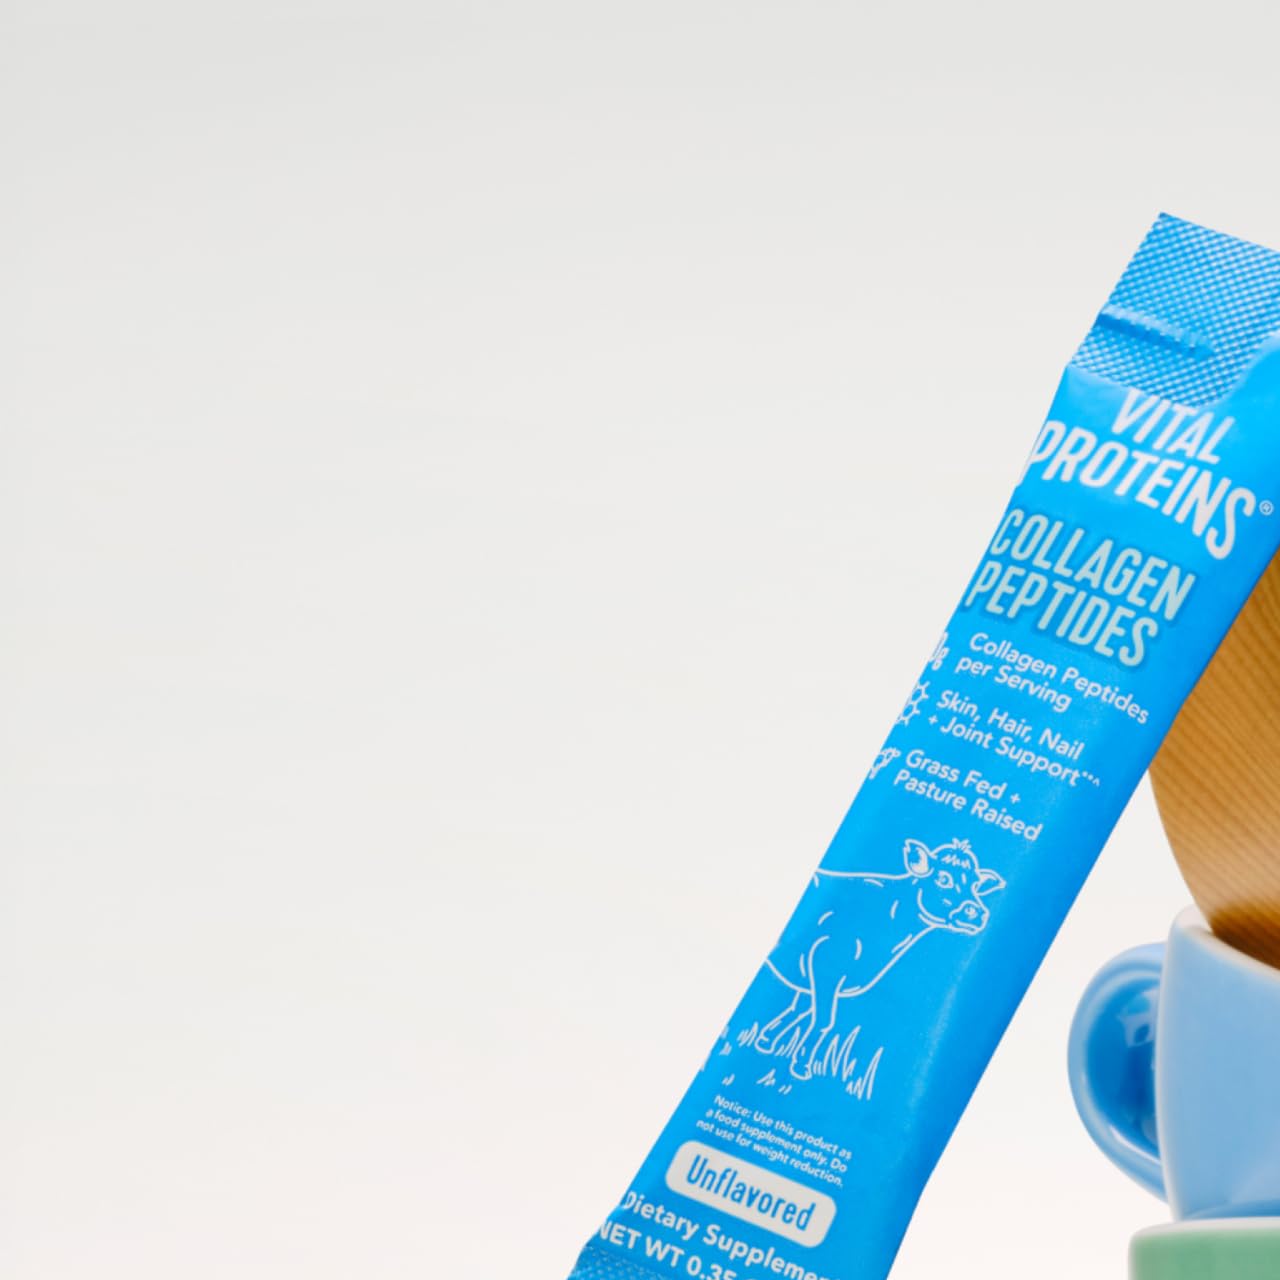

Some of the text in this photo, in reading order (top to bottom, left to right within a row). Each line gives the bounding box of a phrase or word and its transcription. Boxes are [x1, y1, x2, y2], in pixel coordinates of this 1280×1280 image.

[1111, 388, 1235, 464] VITAL
[990, 508, 1196, 621] COLLAGEN
[964, 560, 1158, 667] PEPTIDES
[955, 656, 1072, 712] per Serving
[970, 633, 1149, 724] Collagen Peptides
[936, 690, 1085, 760] Skin, Hair, Nail
[940, 715, 993, 749] Joint
[894, 769, 1043, 842] Pasture Raised
[905, 749, 960, 782] Grass
[964, 769, 1007, 800] Fed
[696, 1119, 844, 1188] not use for weight reduction.
[705, 1108, 848, 1173] a food supplement only. Do
[714, 1094, 853, 1161] Notice: Use this product as
[624, 1190, 700, 1241] Dietary
[686, 1153, 817, 1232] Unflavored
[599, 1220, 642, 1250] NET
[645, 1235, 685, 1267] WT
